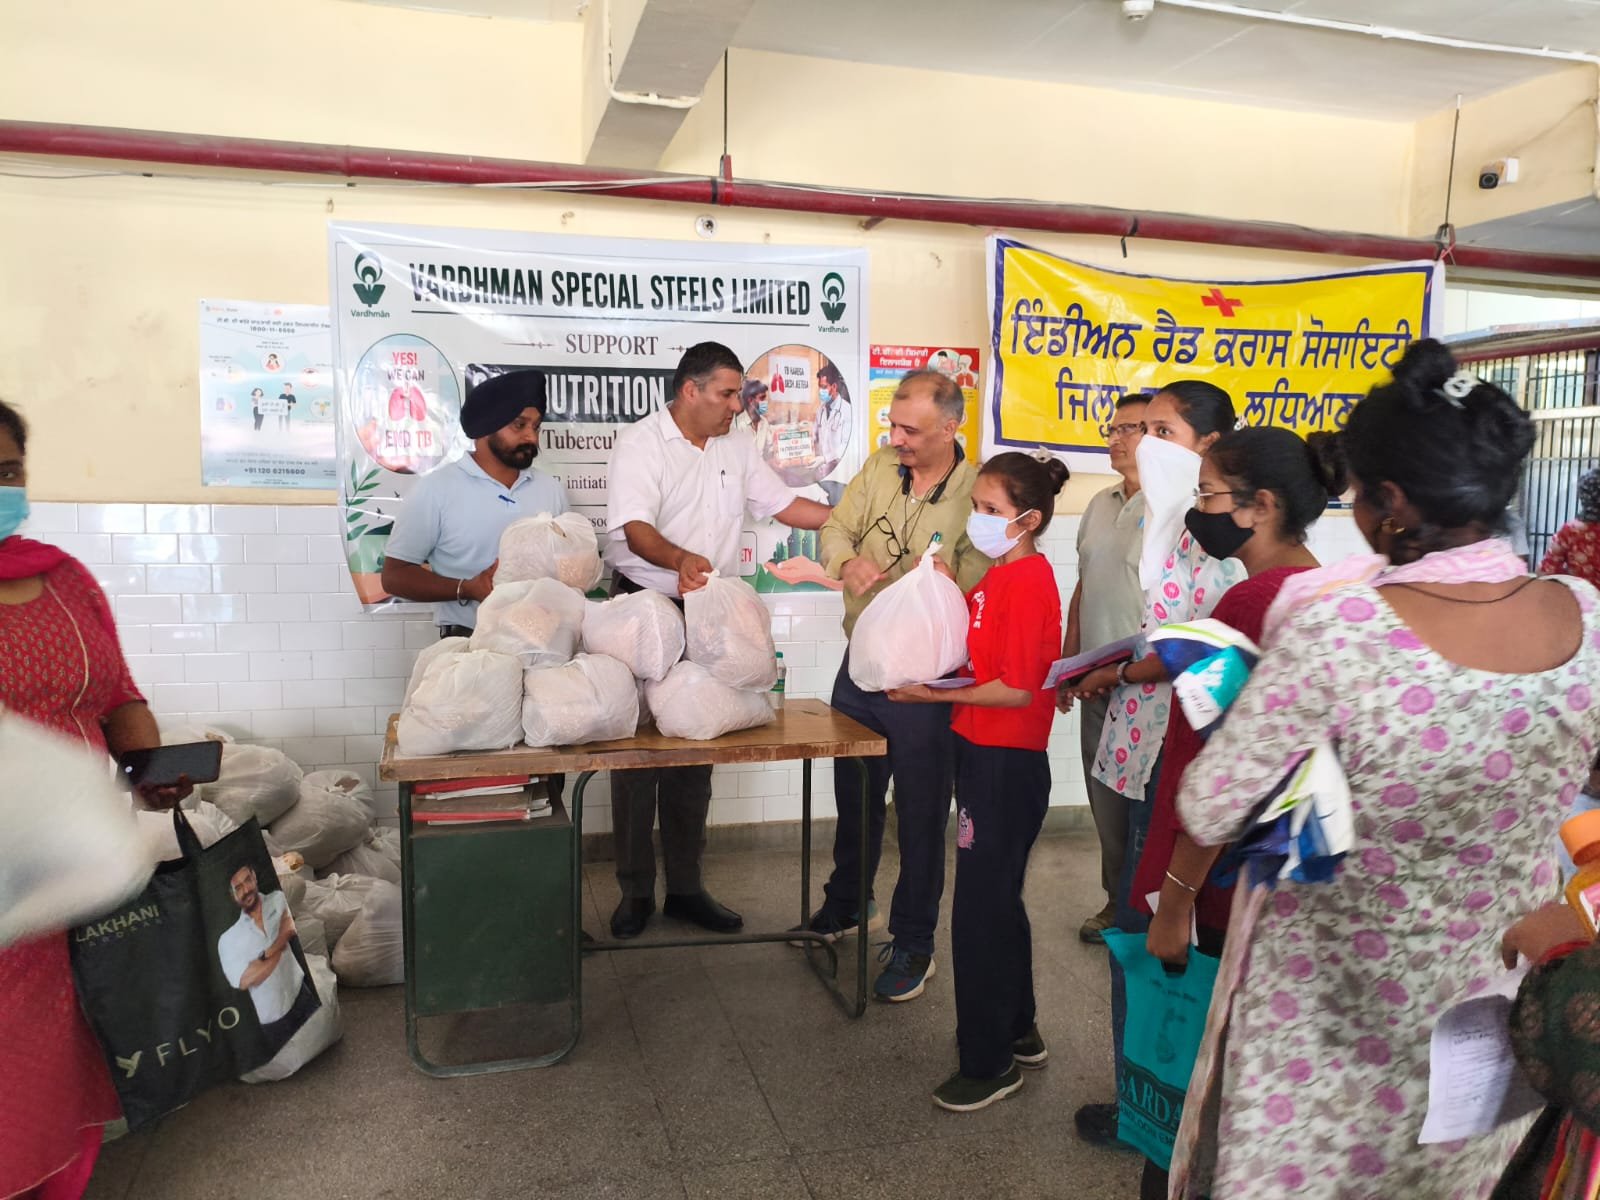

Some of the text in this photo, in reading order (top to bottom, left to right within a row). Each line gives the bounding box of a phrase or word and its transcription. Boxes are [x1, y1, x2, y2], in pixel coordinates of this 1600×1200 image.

[408, 262, 811, 316] VARDHMAN SPECIAL STEELS LIMITED
[565, 332, 660, 356] SUPPORT
[1010, 298, 1143, 360] ਇੰਡੀਅਨ
[1152, 308, 1205, 364] ਰੈਡ
[1214, 327, 1293, 369] ਕਰਾਸ
[392, 351, 418, 366] YES!
[387, 368, 425, 382] WE CAN
[384, 429, 433, 449] END TB
[75, 904, 160, 943] LAKHANI
[155, 1005, 240, 1067] FLYO
